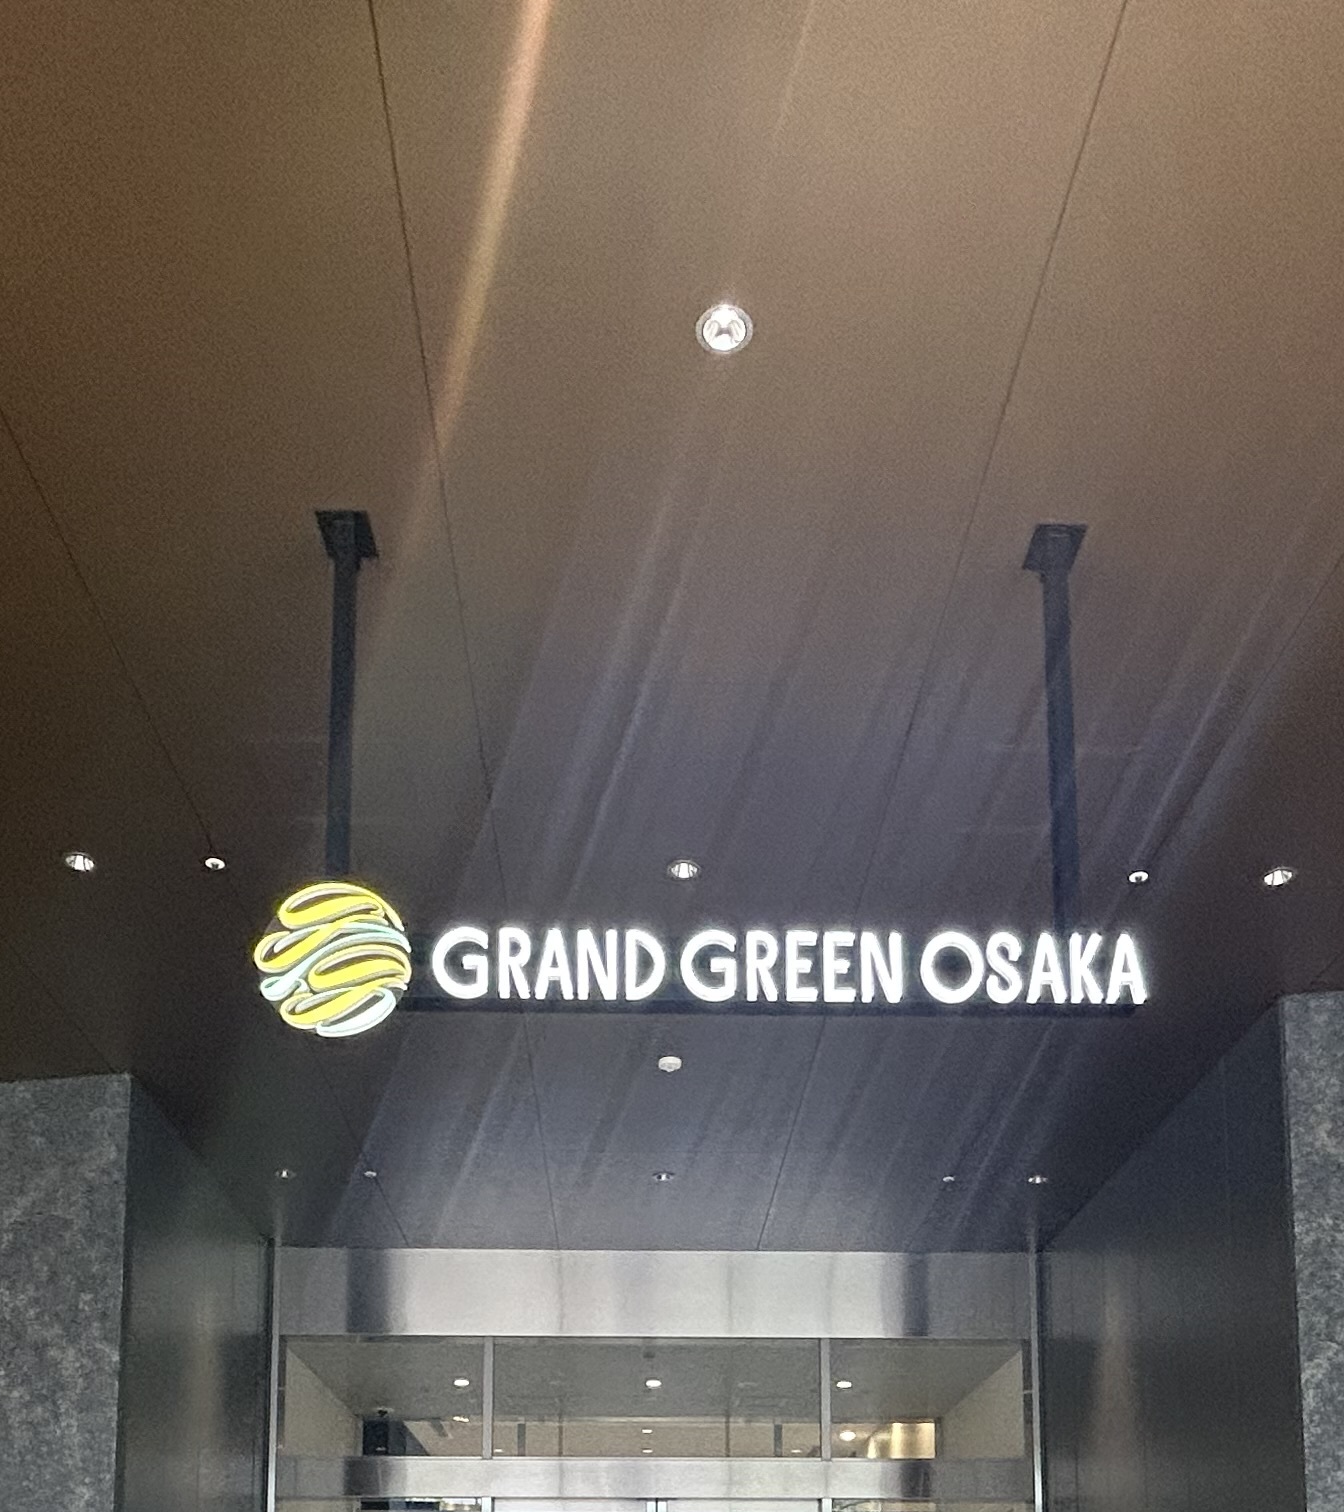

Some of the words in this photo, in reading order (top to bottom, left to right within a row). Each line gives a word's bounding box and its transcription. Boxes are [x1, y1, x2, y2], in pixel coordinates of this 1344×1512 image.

[431, 923, 667, 1001] GRAND
[679, 925, 906, 1004] GREEN
[919, 928, 1148, 1005] OSAKA
